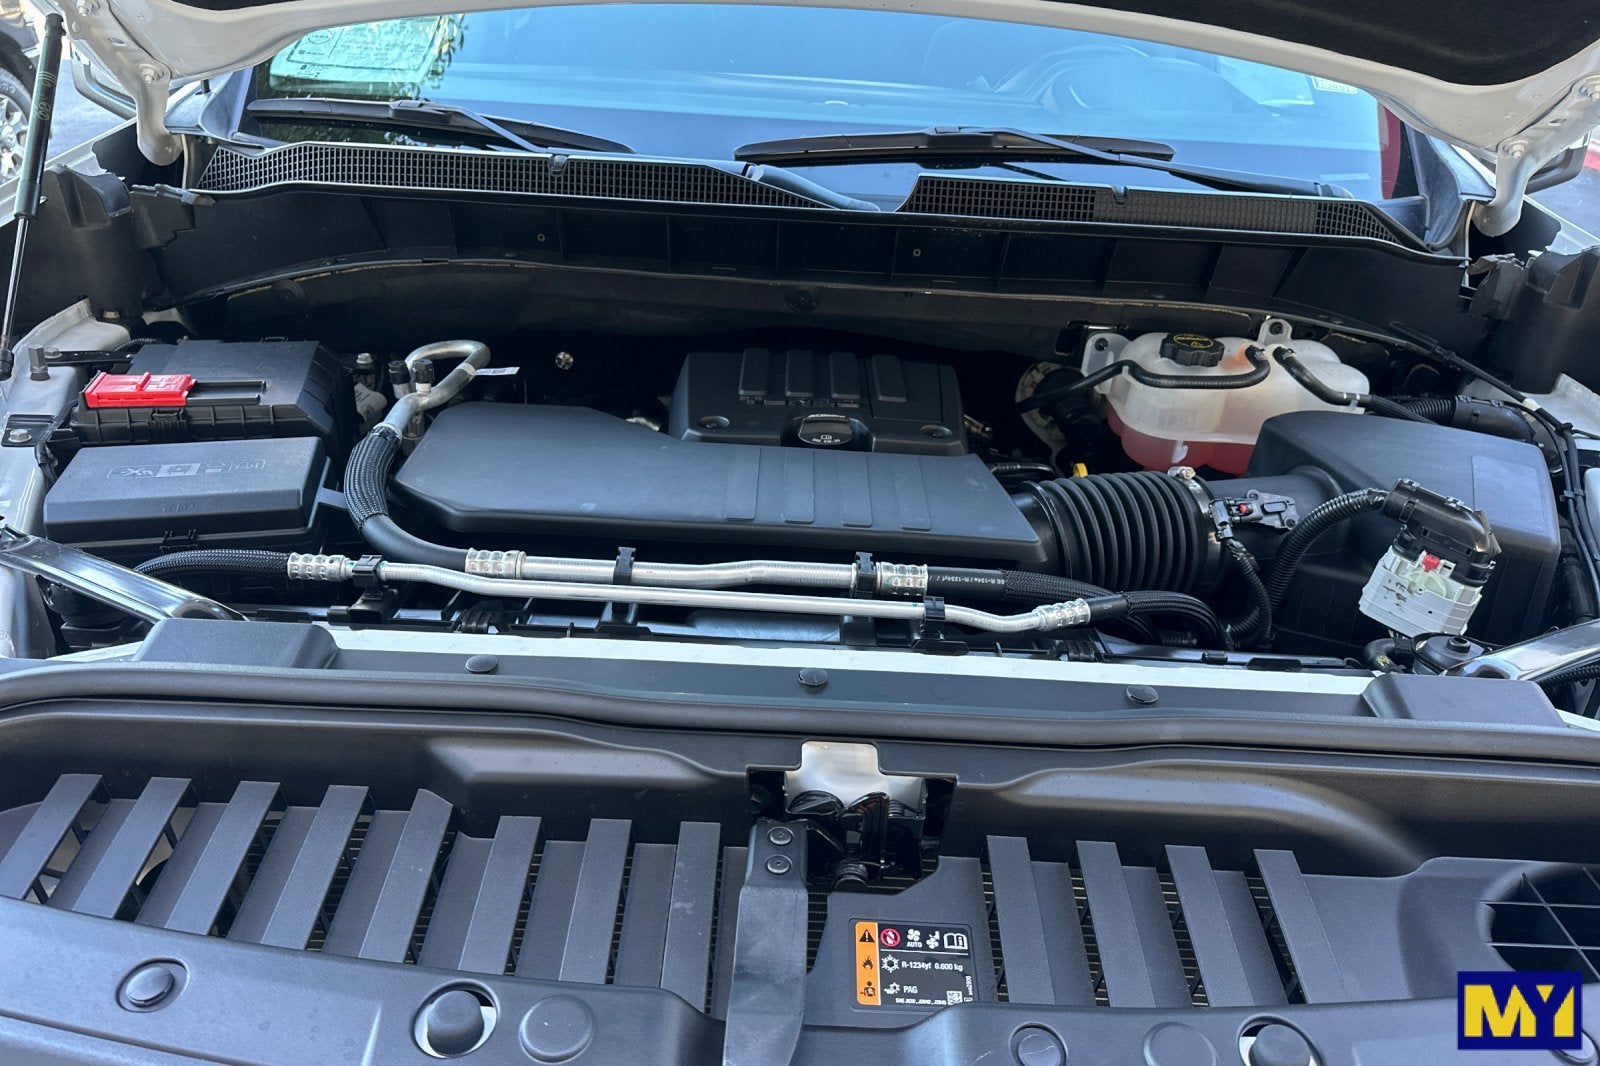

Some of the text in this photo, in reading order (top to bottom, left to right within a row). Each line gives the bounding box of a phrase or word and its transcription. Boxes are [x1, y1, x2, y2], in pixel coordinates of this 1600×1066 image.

[901, 961, 932, 970] R-1234yf
[954, 964, 963, 972] kg
[903, 985, 918, 994] PAG
